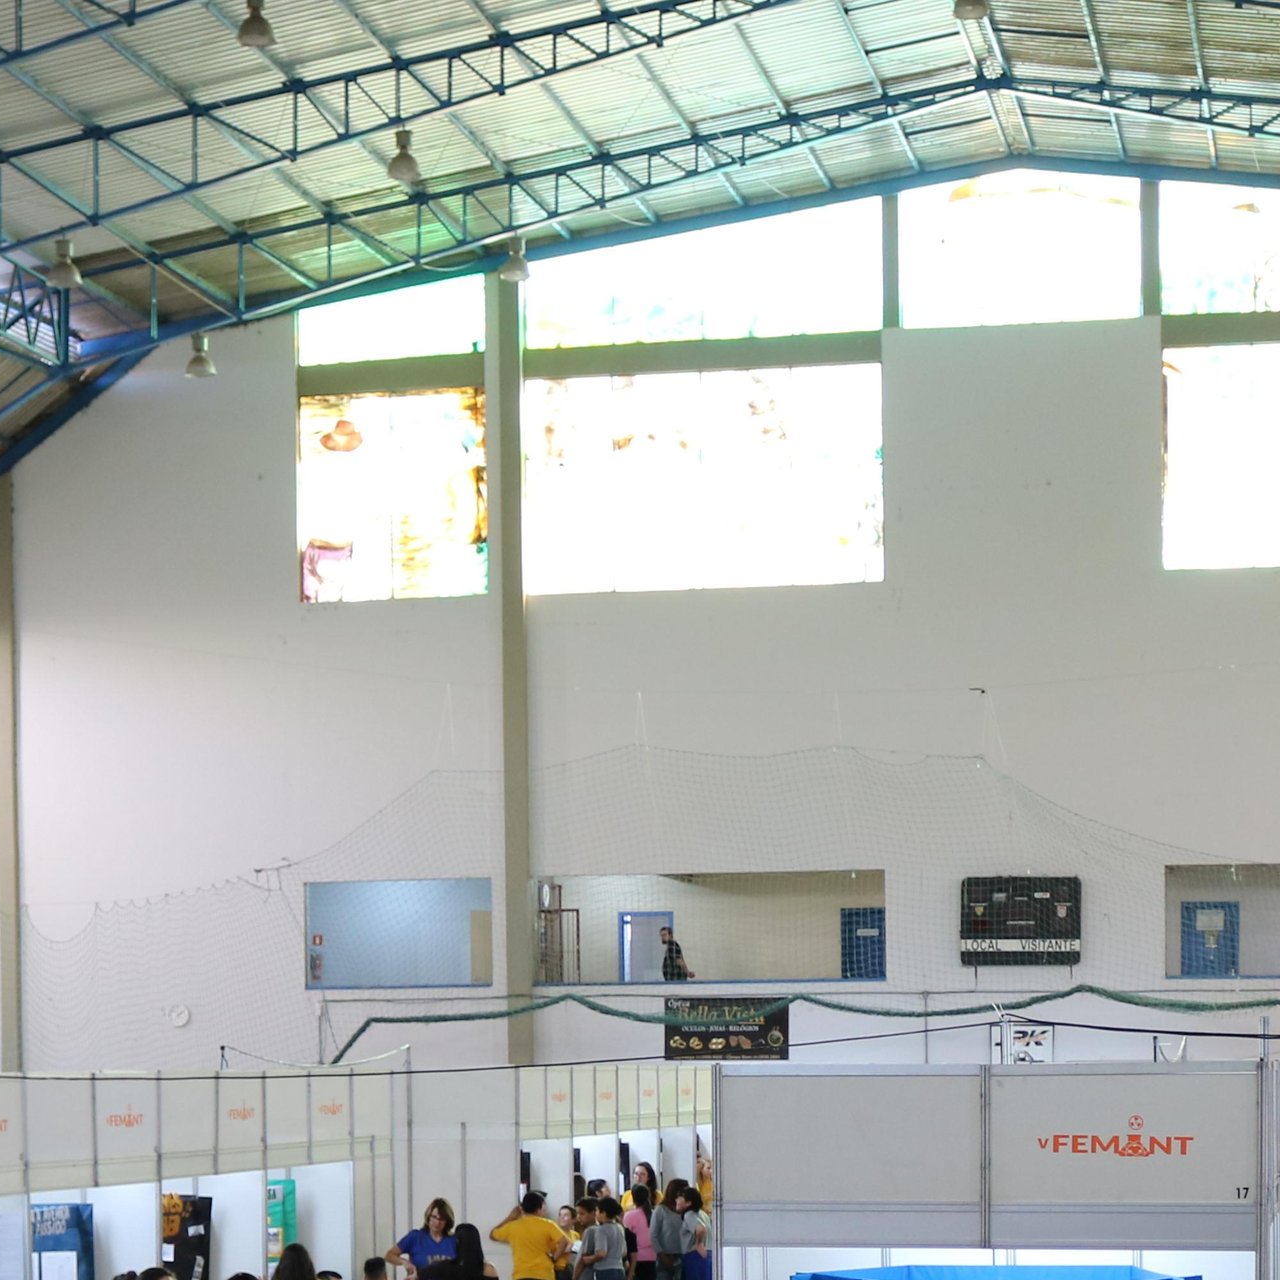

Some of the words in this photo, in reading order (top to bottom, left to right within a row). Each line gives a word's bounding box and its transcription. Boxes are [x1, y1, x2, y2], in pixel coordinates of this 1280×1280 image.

[965, 940, 1001, 951] LOCAL
[1020, 940, 1076, 951] VISITANTE
[1236, 1188, 1250, 1199] 17
